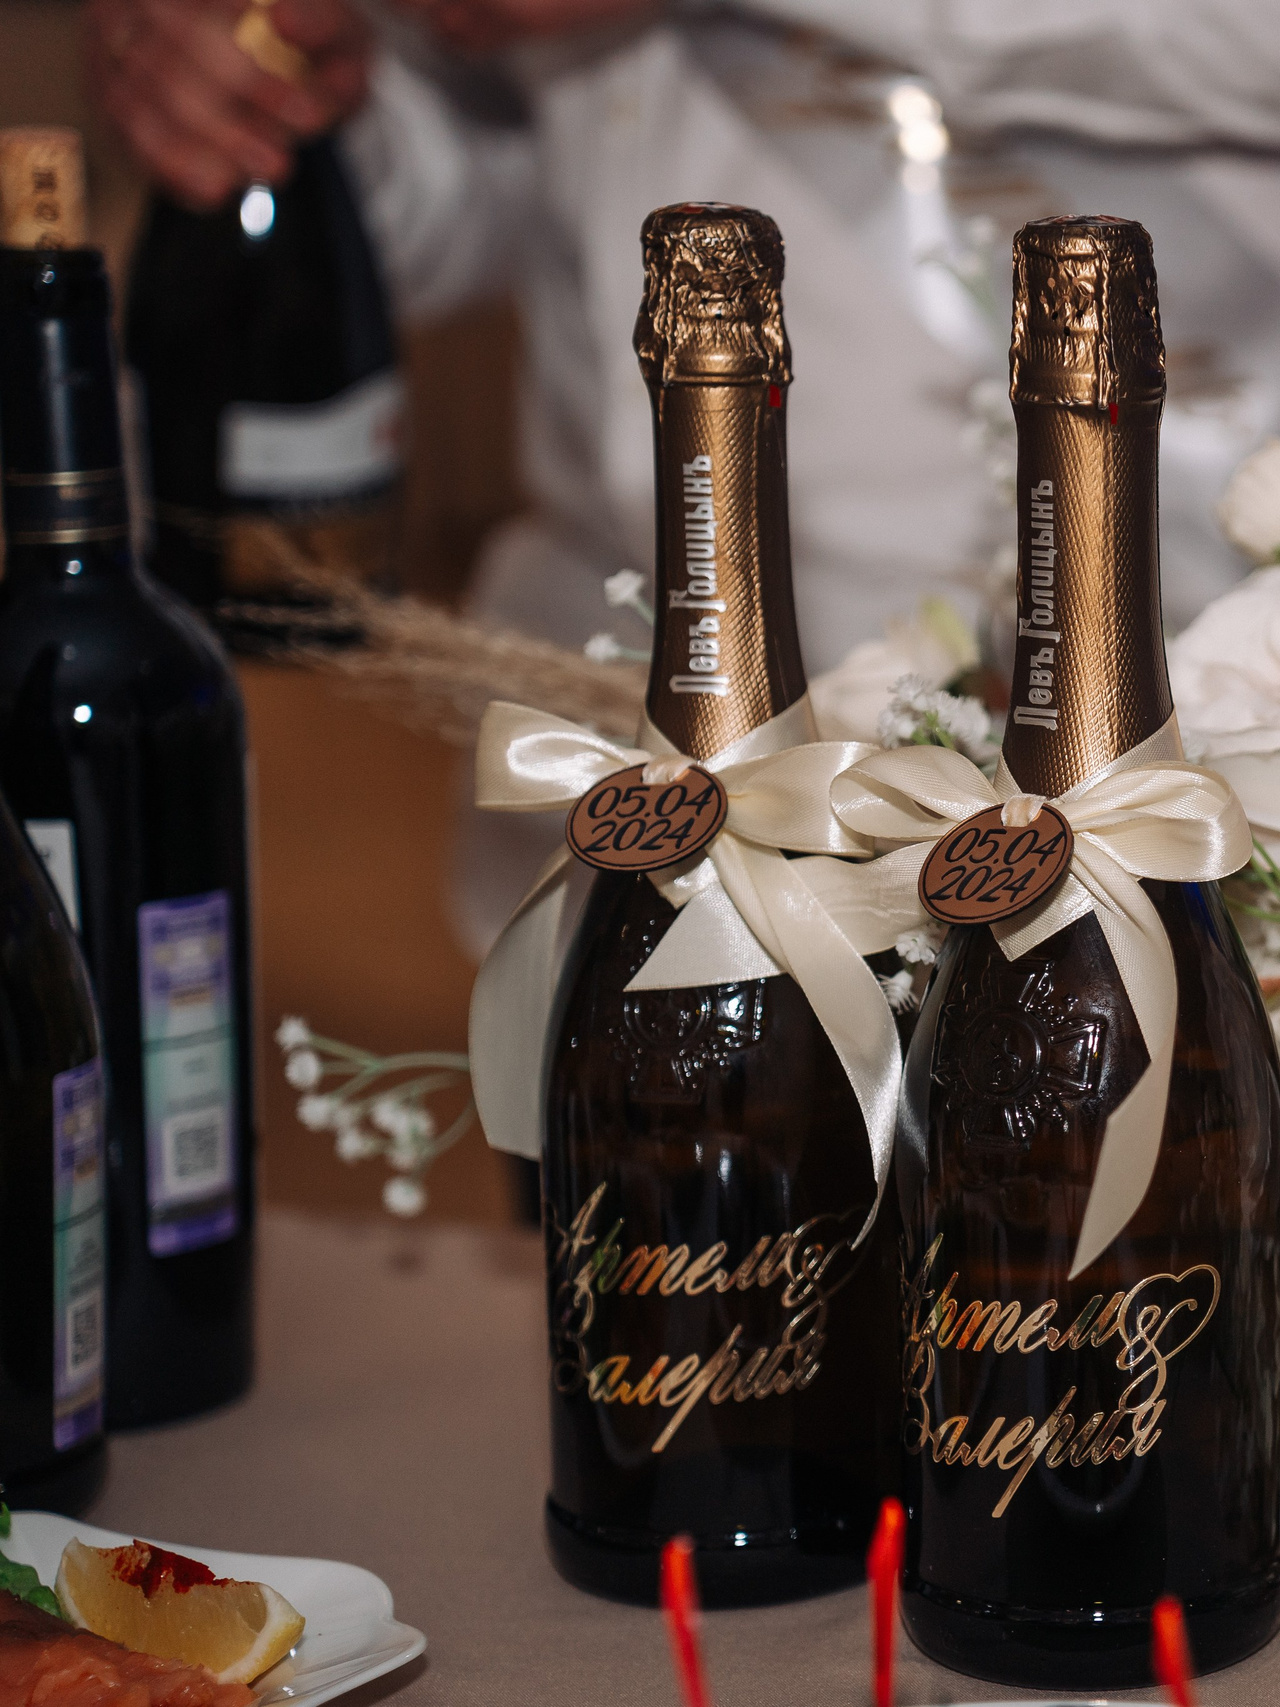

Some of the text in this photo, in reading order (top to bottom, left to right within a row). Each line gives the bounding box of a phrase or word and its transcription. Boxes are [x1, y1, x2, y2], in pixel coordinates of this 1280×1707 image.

[669, 454, 730, 696] Левъ Голицынъ
[1014, 479, 1060, 731] Левъ Голицынъ
[587, 782, 716, 819] 05.04
[582, 817, 695, 852] 2024
[944, 827, 1065, 867] 05.04
[927, 865, 1036, 903] 2024
